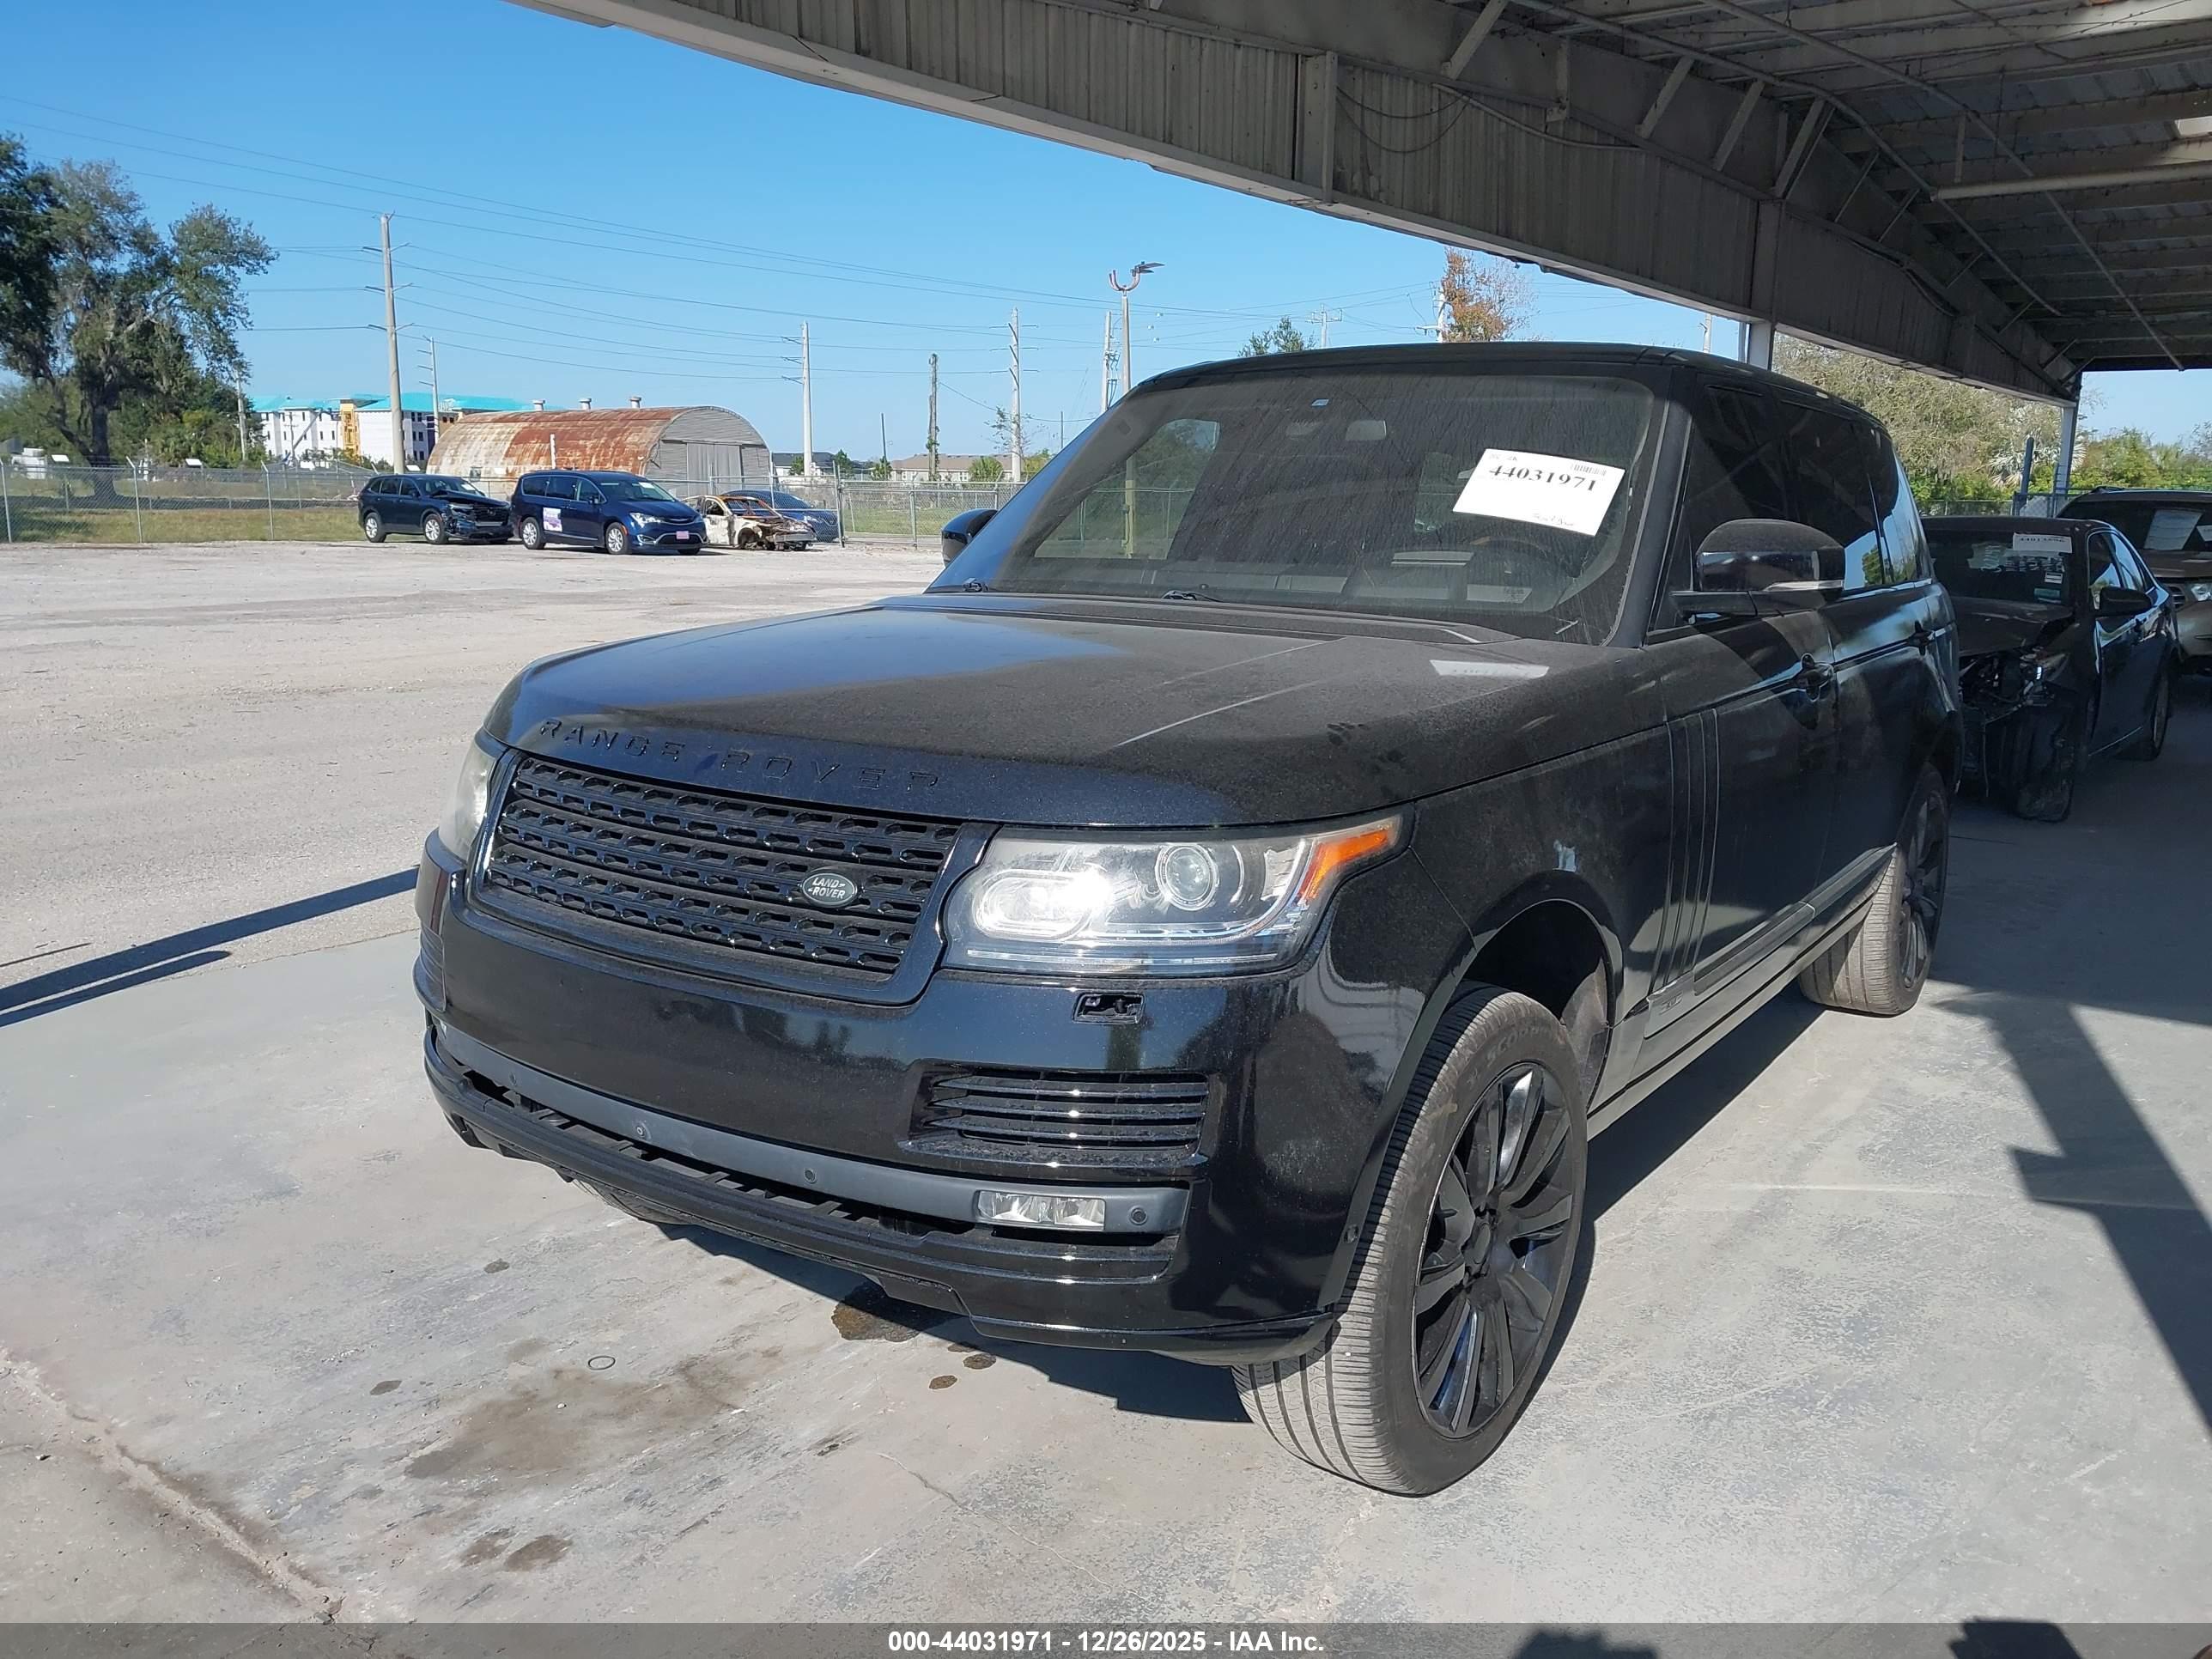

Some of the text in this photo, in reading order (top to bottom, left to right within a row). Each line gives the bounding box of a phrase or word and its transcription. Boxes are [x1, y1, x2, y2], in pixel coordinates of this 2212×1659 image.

[1488, 465, 1597, 491] 44031971
[720, 750, 939, 793] ROVER
[811, 877, 839, 888] LAND
[811, 887, 846, 899] ROVER
